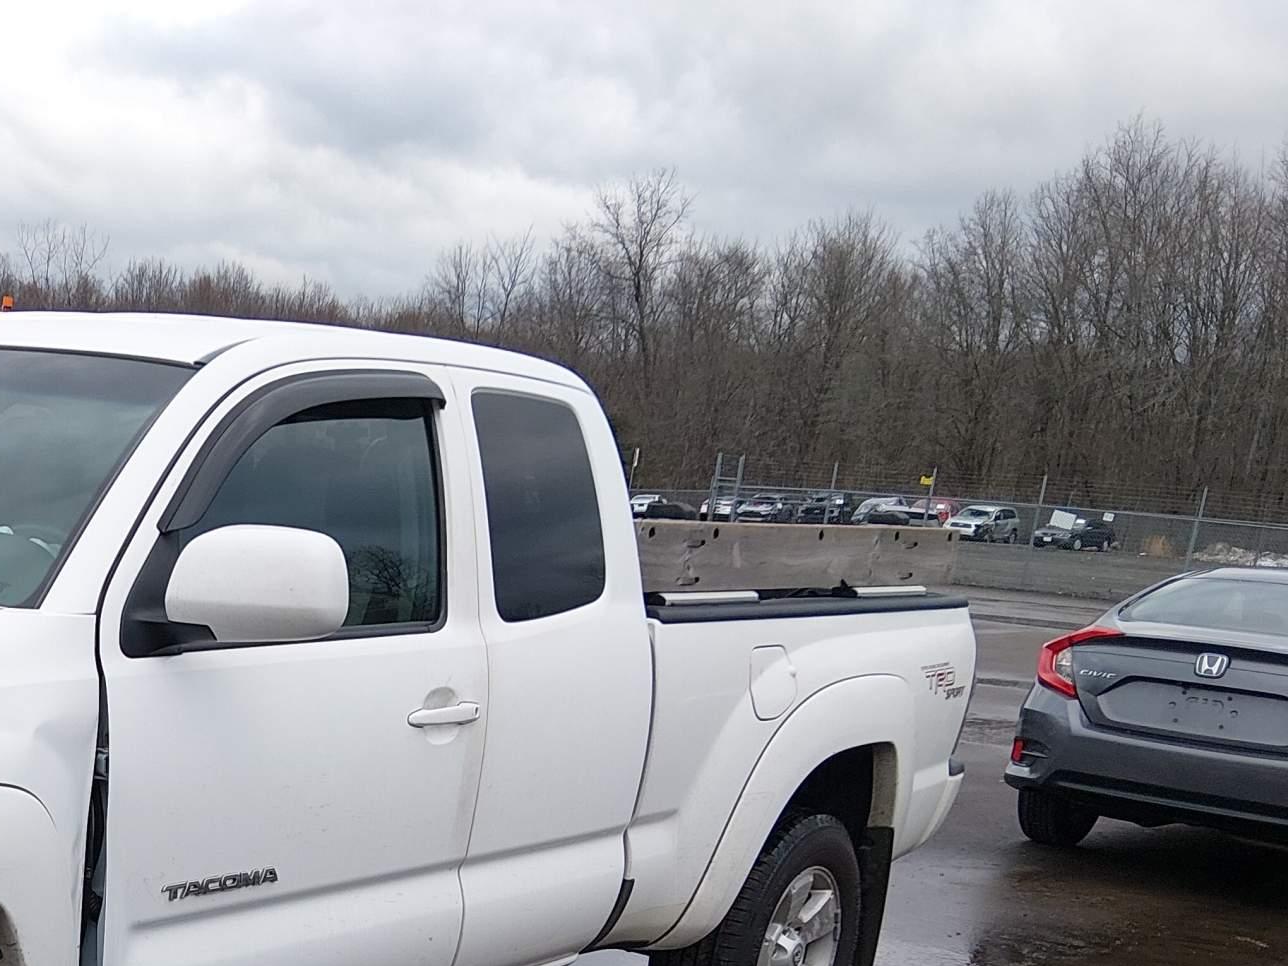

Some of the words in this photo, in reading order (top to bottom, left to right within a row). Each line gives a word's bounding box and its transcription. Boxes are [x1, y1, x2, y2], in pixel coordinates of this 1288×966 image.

[925, 667, 956, 695] TRD
[1079, 669, 1117, 679] CIVIC
[161, 867, 279, 902] TACOMA
